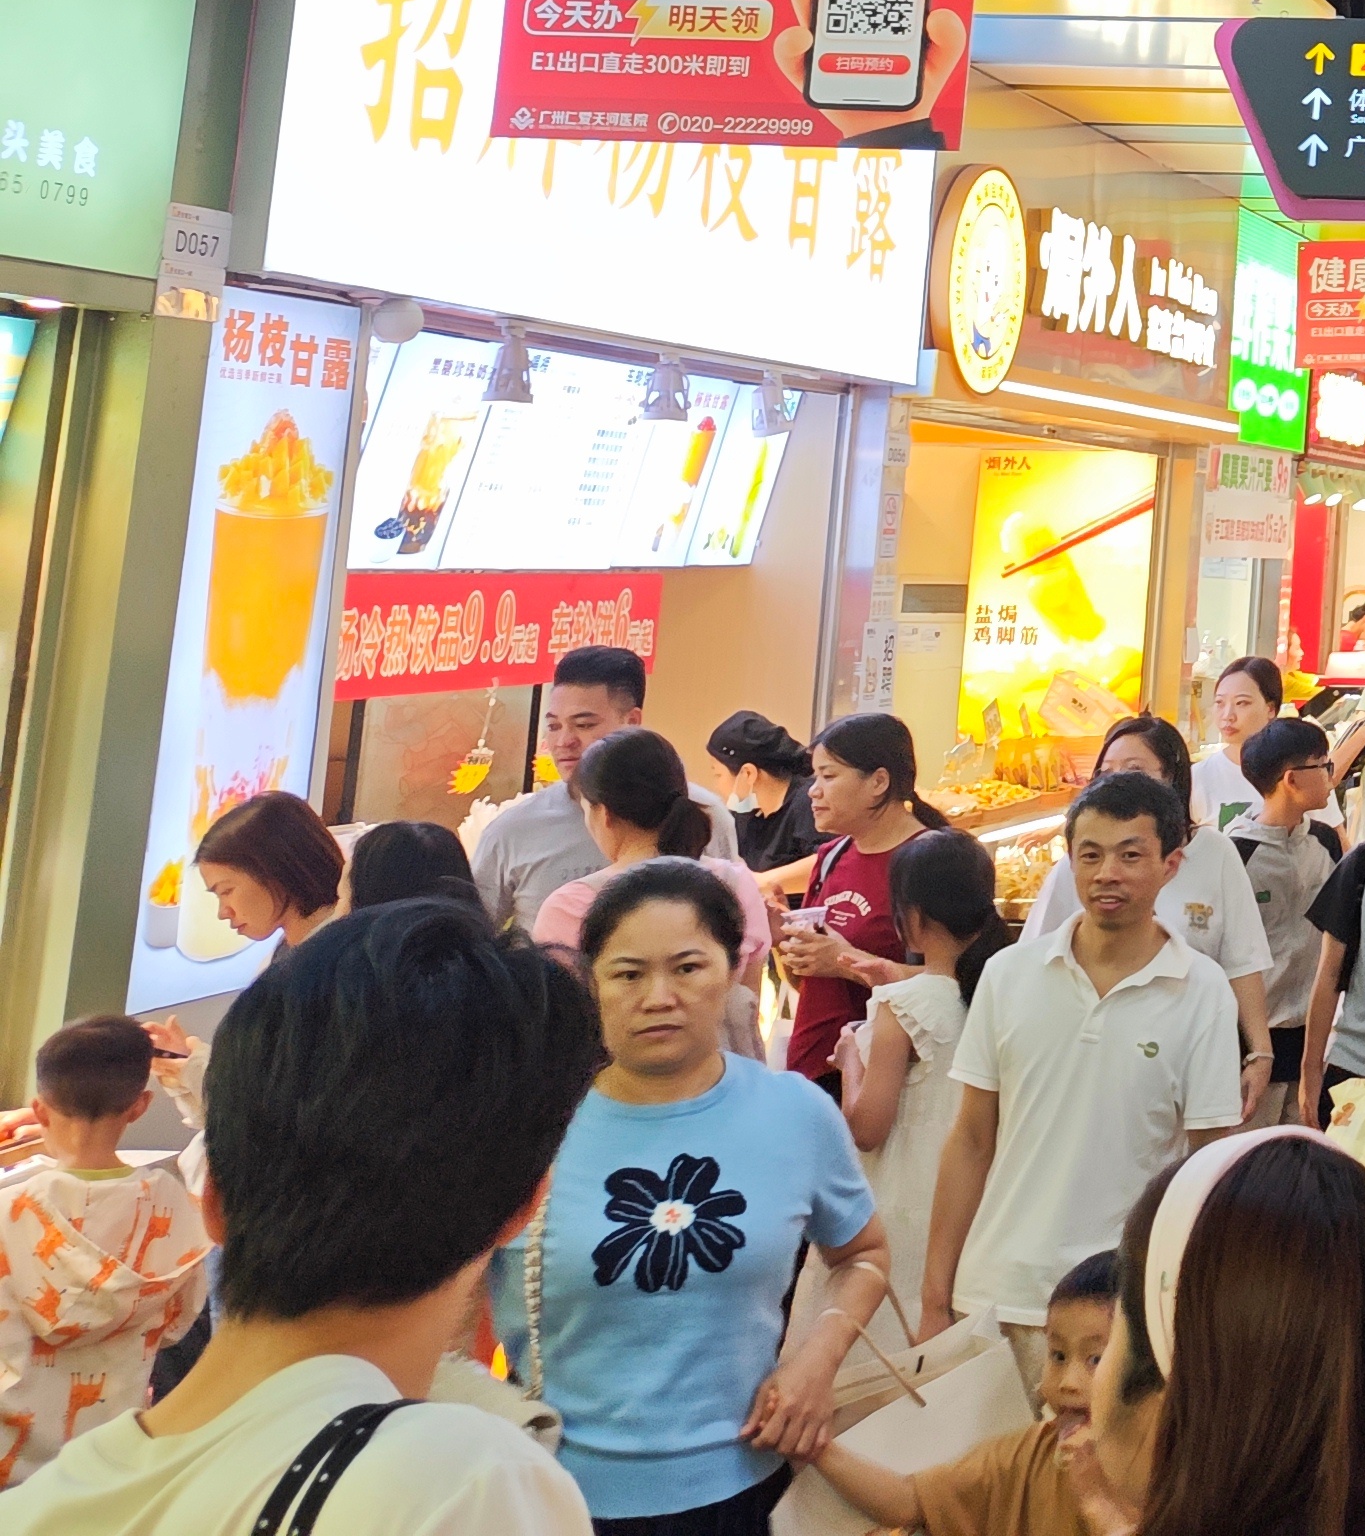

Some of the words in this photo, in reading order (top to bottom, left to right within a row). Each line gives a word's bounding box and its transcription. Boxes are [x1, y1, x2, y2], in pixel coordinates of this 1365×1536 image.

[533, 0, 623, 30] 今天办
[667, 4, 760, 35] 明天领
[531, 51, 751, 78] E1出口直走300米即到
[835, 55, 894, 73] 扫码预约
[678, 114, 814, 136] 020-22229999
[40, 179, 88, 206] 0799
[176, 230, 219, 257] D057
[1310, 302, 1354, 317] 今天办
[223, 309, 352, 390] 杨枝甘露
[975, 605, 1018, 624] 盐焗
[973, 626, 1039, 646] 鸡脚筋
